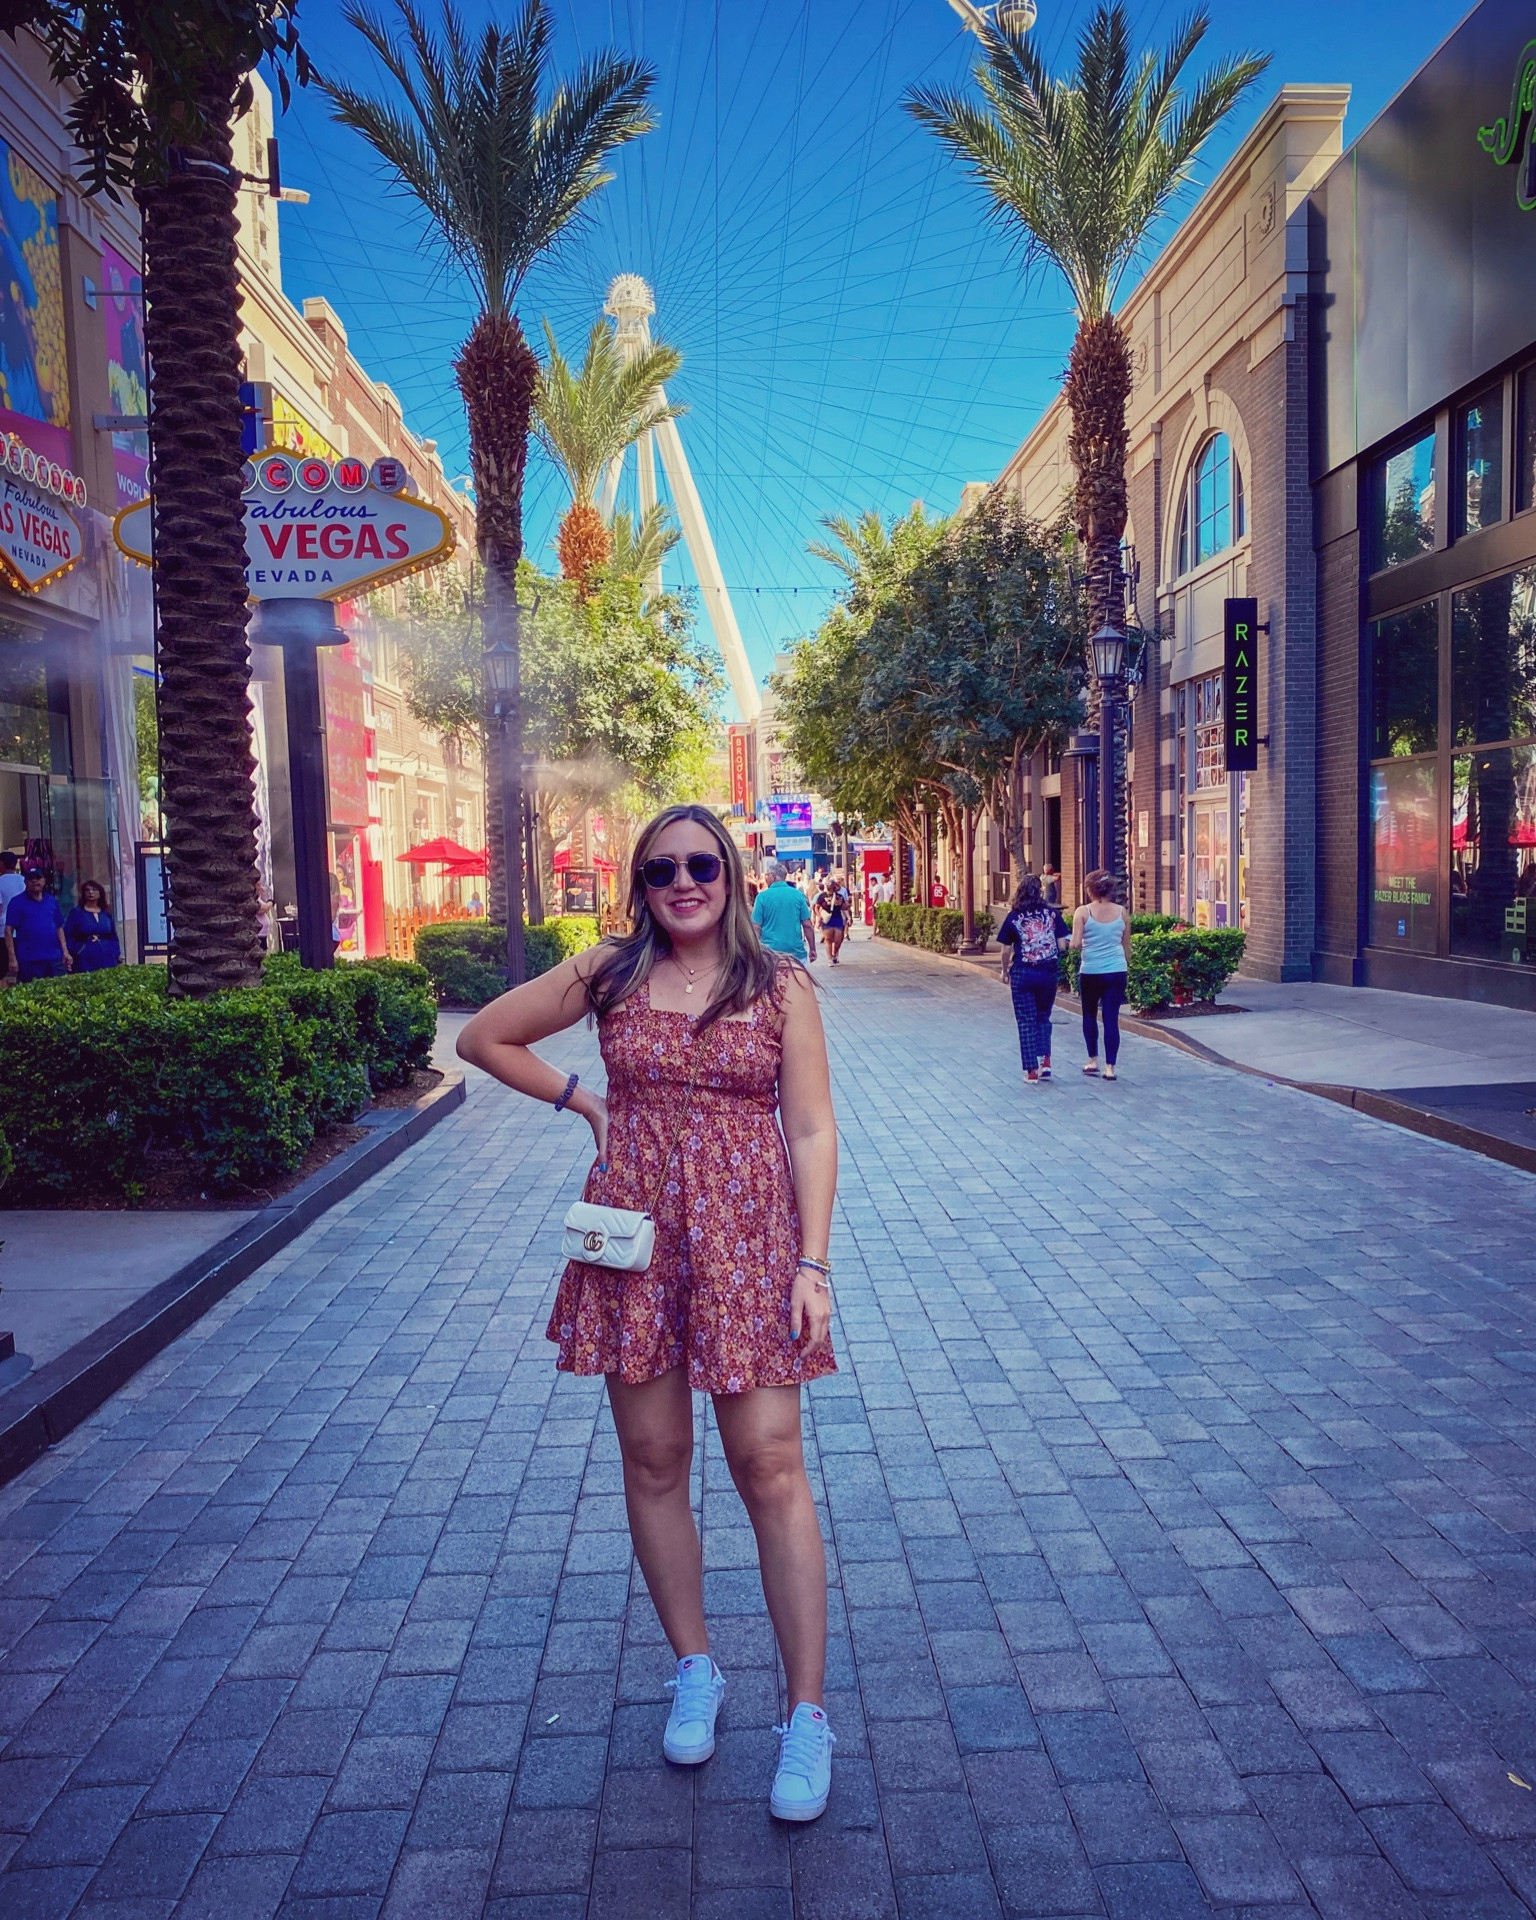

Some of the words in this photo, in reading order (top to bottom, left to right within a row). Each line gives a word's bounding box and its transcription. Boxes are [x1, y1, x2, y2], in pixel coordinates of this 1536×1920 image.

[244, 463, 398, 487] COME
[4, 480, 58, 521] Fabulous
[240, 499, 378, 519] abulous
[18, 508, 71, 560] VEGAS
[259, 524, 410, 560] VEGAS
[11, 544, 47, 569] NEVADA
[1405, 877, 1417, 889] THE
